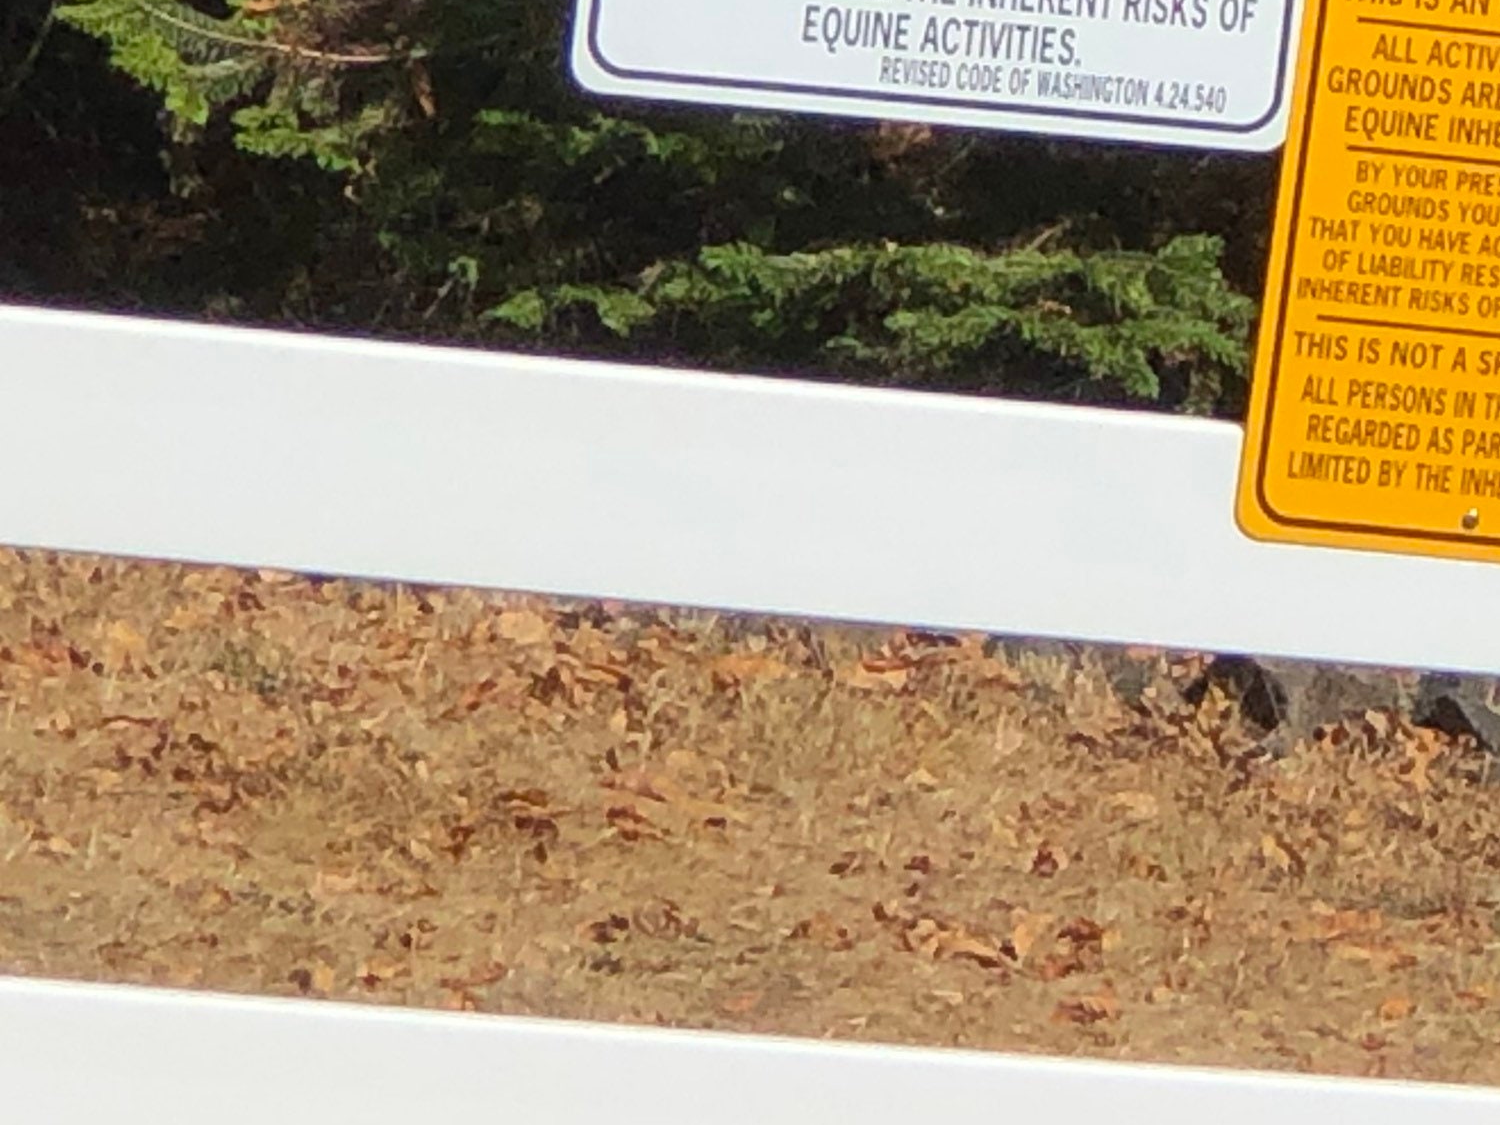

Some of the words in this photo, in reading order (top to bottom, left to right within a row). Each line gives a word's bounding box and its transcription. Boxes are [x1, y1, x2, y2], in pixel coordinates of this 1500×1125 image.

[802, 4, 912, 54] EQUINE
[919, 16, 1081, 66] ACTIVITIES.
[1371, 33, 1418, 65] ALL
[878, 55, 951, 89] REVISED
[955, 62, 1003, 94] CODE
[1008, 66, 1032, 96] OF
[1037, 70, 1150, 107] WASHINGTON
[1153, 80, 1227, 114] 4.24.540
[1327, 65, 1453, 106] GROUNDS
[1344, 105, 1440, 142] EQUINE
[1355, 159, 1385, 184] BY
[1392, 164, 1448, 191] YOUR
[1346, 189, 1450, 223] GROUNDS
[1308, 215, 1361, 242] THAT
[1369, 223, 1412, 249] YOU
[1417, 228, 1472, 255] HAVE
[1322, 248, 1352, 273] OF
[1356, 251, 1455, 283] LIABILITY
[1296, 276, 1403, 308] INHERENT
[1407, 287, 1470, 316] RISKS
[1293, 330, 1349, 362] THIS
[1357, 337, 1382, 365] IS
[1389, 340, 1444, 370] NOT
[1450, 346, 1467, 373] A
[1300, 374, 1339, 407] ALL
[1346, 378, 1448, 416] PERSONS
[1453, 390, 1477, 419] IN
[1306, 413, 1421, 452] REGARDED
[1426, 425, 1454, 456] AS
[1287, 450, 1371, 485] LIMITED
[1377, 459, 1408, 488] BY
[1415, 462, 1453, 494] THE
